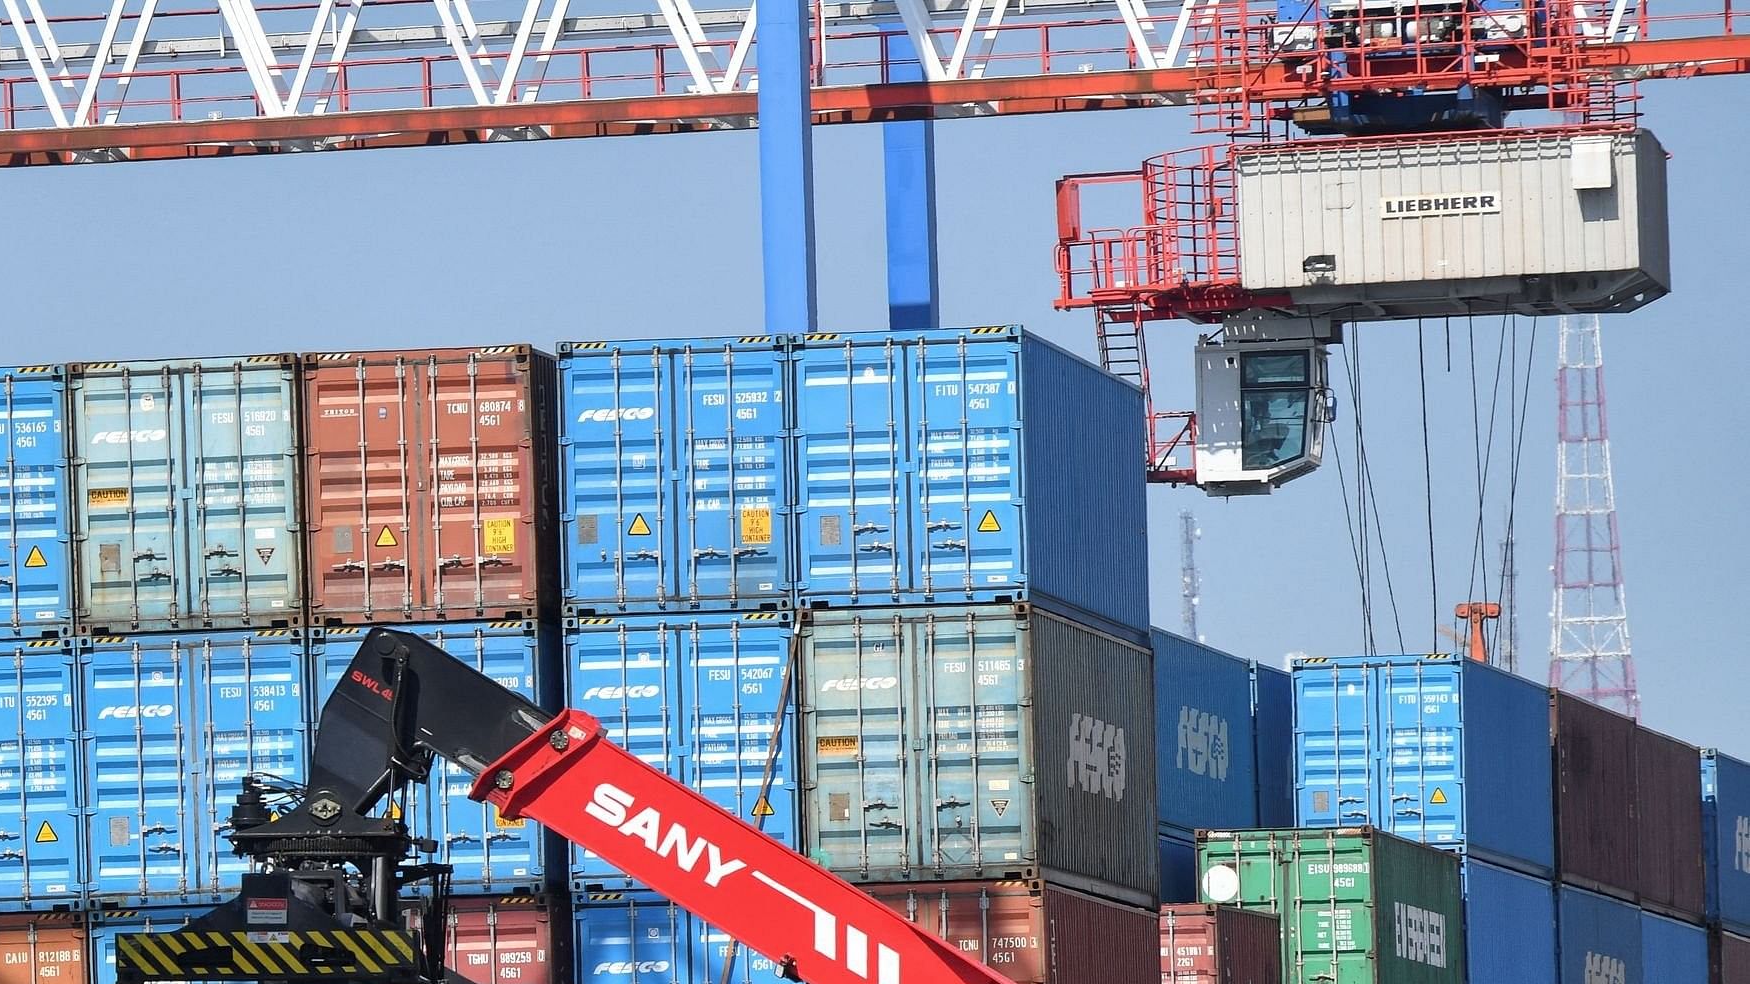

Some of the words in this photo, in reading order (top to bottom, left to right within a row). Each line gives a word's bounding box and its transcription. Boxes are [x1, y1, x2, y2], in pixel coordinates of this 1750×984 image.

[1385, 194, 1495, 214] LIEBHERR
[936, 385, 958, 396] FITU
[968, 383, 1000, 394] 547387
[703, 395, 724, 406] FESU
[735, 392, 767, 403] 525932
[969, 398, 989, 409] 45G1
[447, 403, 468, 414] TCNU
[479, 401, 511, 412] 680874
[736, 408, 756, 419] 45G1
[212, 413, 234, 424] FESU
[244, 410, 276, 422] 516920
[479, 415, 500, 426] 45G1
[577, 407, 654, 423] FESCO
[15, 422, 47, 434] 536165
[245, 425, 265, 436] 45G1
[16, 437, 36, 448] 45G1
[91, 429, 166, 444] FESCO
[91, 490, 128, 499] CAUTION
[944, 662, 966, 673] FESU
[978, 660, 1010, 671] 511465
[1018, 659, 1025, 671] 3
[709, 670, 730, 680] FESU
[742, 668, 772, 679] 542067
[978, 674, 998, 685] 45G1
[351, 670, 380, 695] SWL
[742, 683, 762, 693] 45G1
[821, 676, 897, 691] FESCO
[220, 687, 242, 698] FESU
[254, 685, 286, 697] 538413
[583, 685, 659, 700] FESCO
[26, 695, 57, 706] 552395
[254, 700, 274, 711] 45G1
[27, 710, 47, 721] 45G1
[98, 705, 174, 719] FESCO
[819, 738, 856, 748] CAUTION
[585, 783, 747, 887] SANY
[1308, 863, 1330, 875] EISU
[1334, 878, 1355, 887] 45G1
[959, 939, 978, 951] TCNU
[993, 938, 1026, 948] 747500
[5, 952, 27, 964] CAIU
[39, 951, 71, 962] 812188
[467, 954, 489, 965] TGHU
[500, 952, 531, 963] 989259
[993, 952, 1014, 963] 45G1
[594, 960, 669, 975] FESCO
[752, 960, 773, 970] 45G1
[39, 966, 60, 977] 45G1
[500, 968, 521, 978] 45G1
